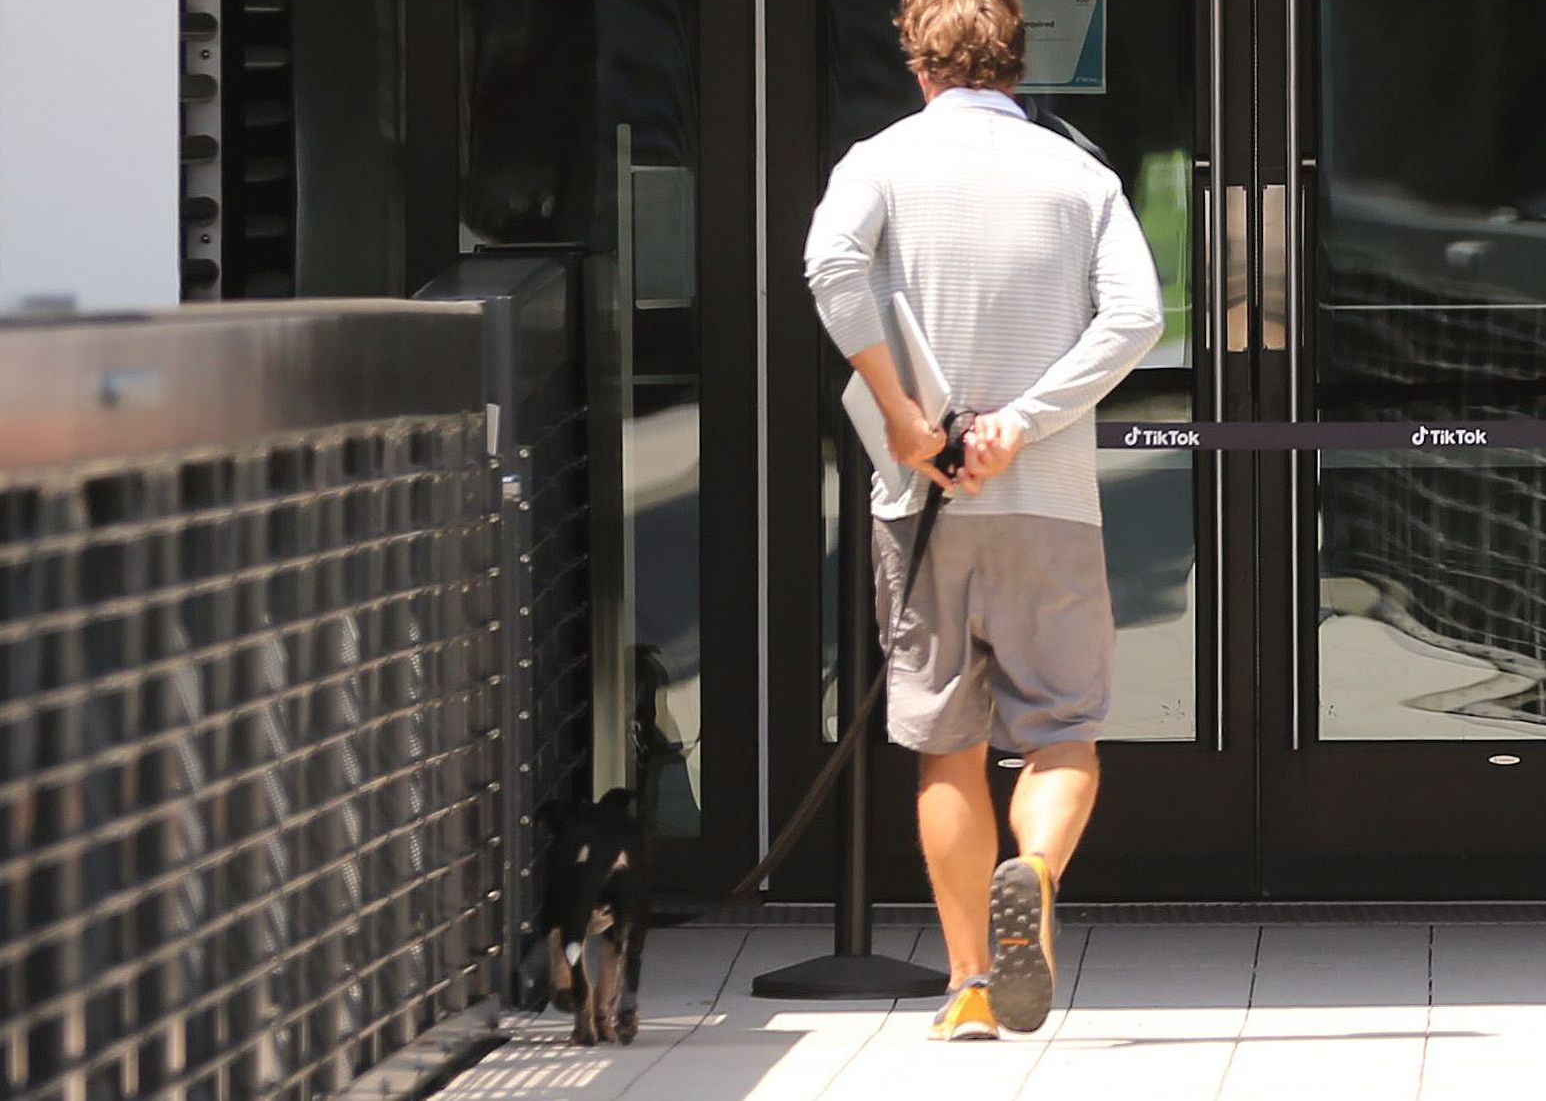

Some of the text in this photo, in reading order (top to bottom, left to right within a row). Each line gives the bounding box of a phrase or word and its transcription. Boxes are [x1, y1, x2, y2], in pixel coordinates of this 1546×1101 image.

[1023, 19, 1056, 30] equired
[1143, 429, 1200, 446] TikTok
[1430, 429, 1487, 445] TikTok
